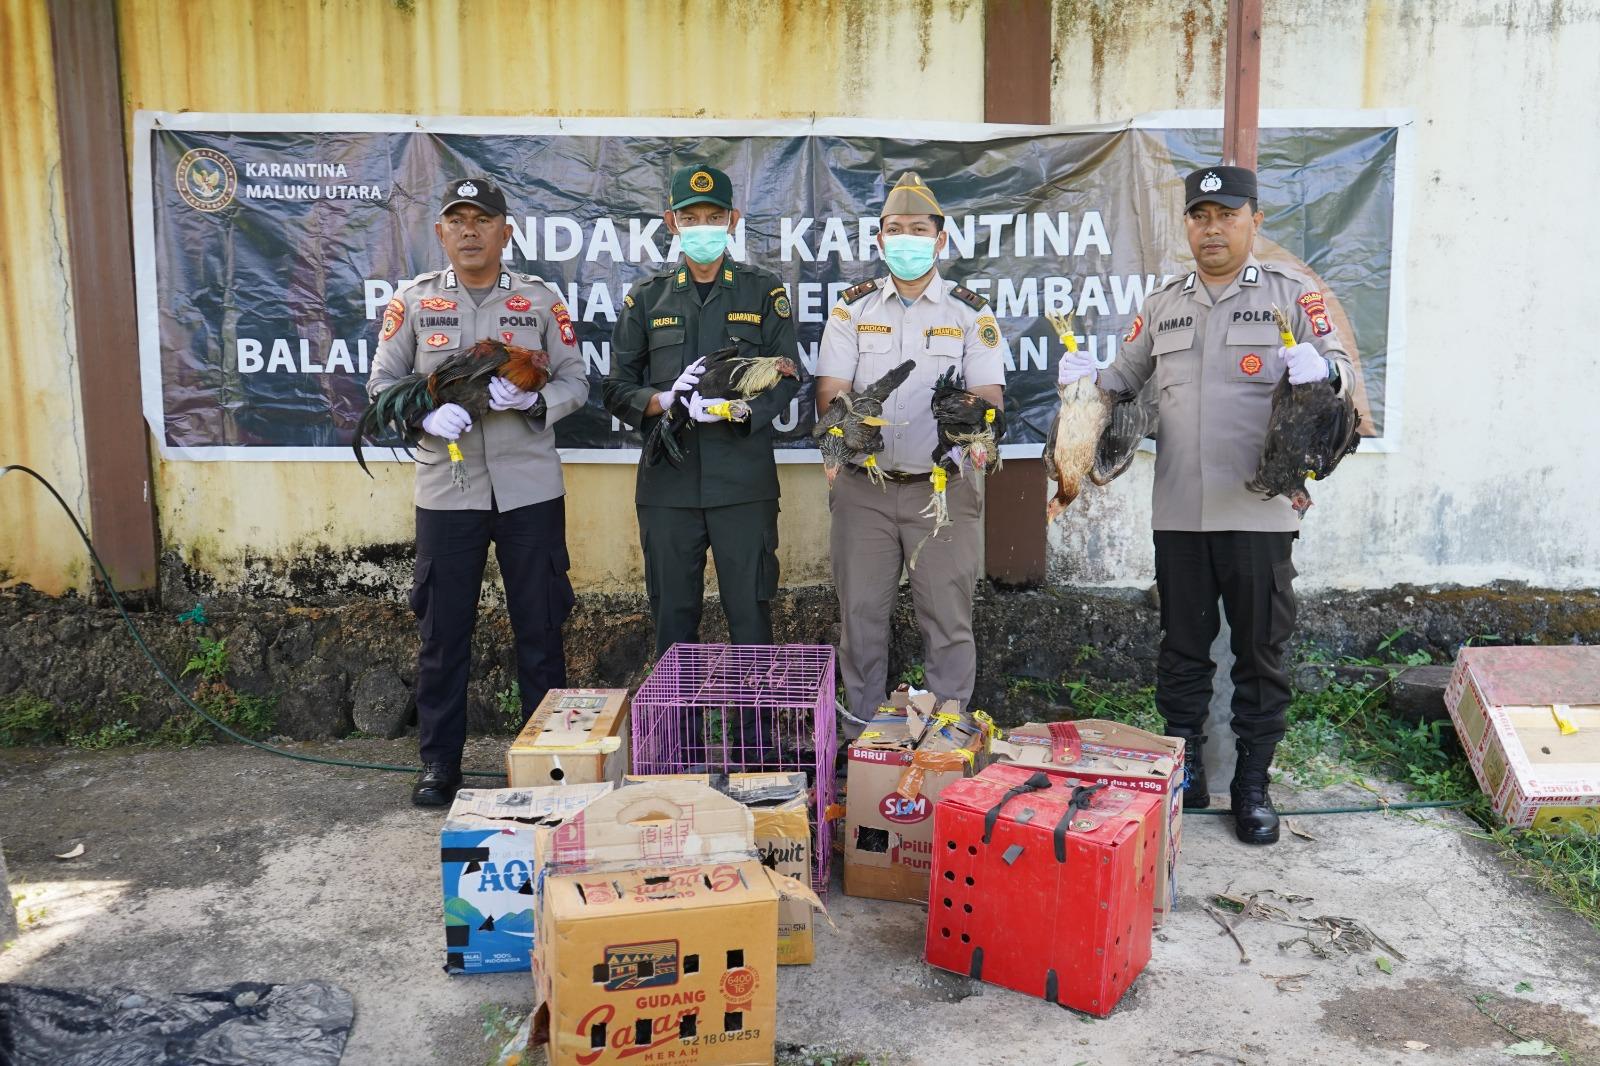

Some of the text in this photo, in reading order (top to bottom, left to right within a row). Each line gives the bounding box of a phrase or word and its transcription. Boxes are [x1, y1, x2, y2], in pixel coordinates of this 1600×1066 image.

[245, 162, 348, 177] KARANTINA
[246, 184, 382, 199] MALUKU UTARA
[502, 211, 1112, 263] NDAKN KARNTINA
[966, 273, 1174, 318] MBAW
[499, 316, 537, 328] POLRI
[653, 317, 678, 328] RUSLI
[728, 312, 762, 324] QUARANTINE
[1158, 316, 1193, 333] AHMAD
[859, 325, 888, 333] ARDIAN
[236, 338, 368, 374] BALAI
[853, 749, 887, 761] BARU!
[1139, 781, 1162, 791] 150g
[664, 824, 673, 848] TYPE
[755, 841, 805, 865] skuit
[903, 857, 931, 870] Bun
[478, 859, 534, 893] AQ
[727, 974, 752, 985] 6400
[735, 985, 745, 993] 16
[636, 990, 706, 1009] GUDANG
[576, 1004, 702, 1066] Gaam
[645, 1048, 699, 1061] MERAH
